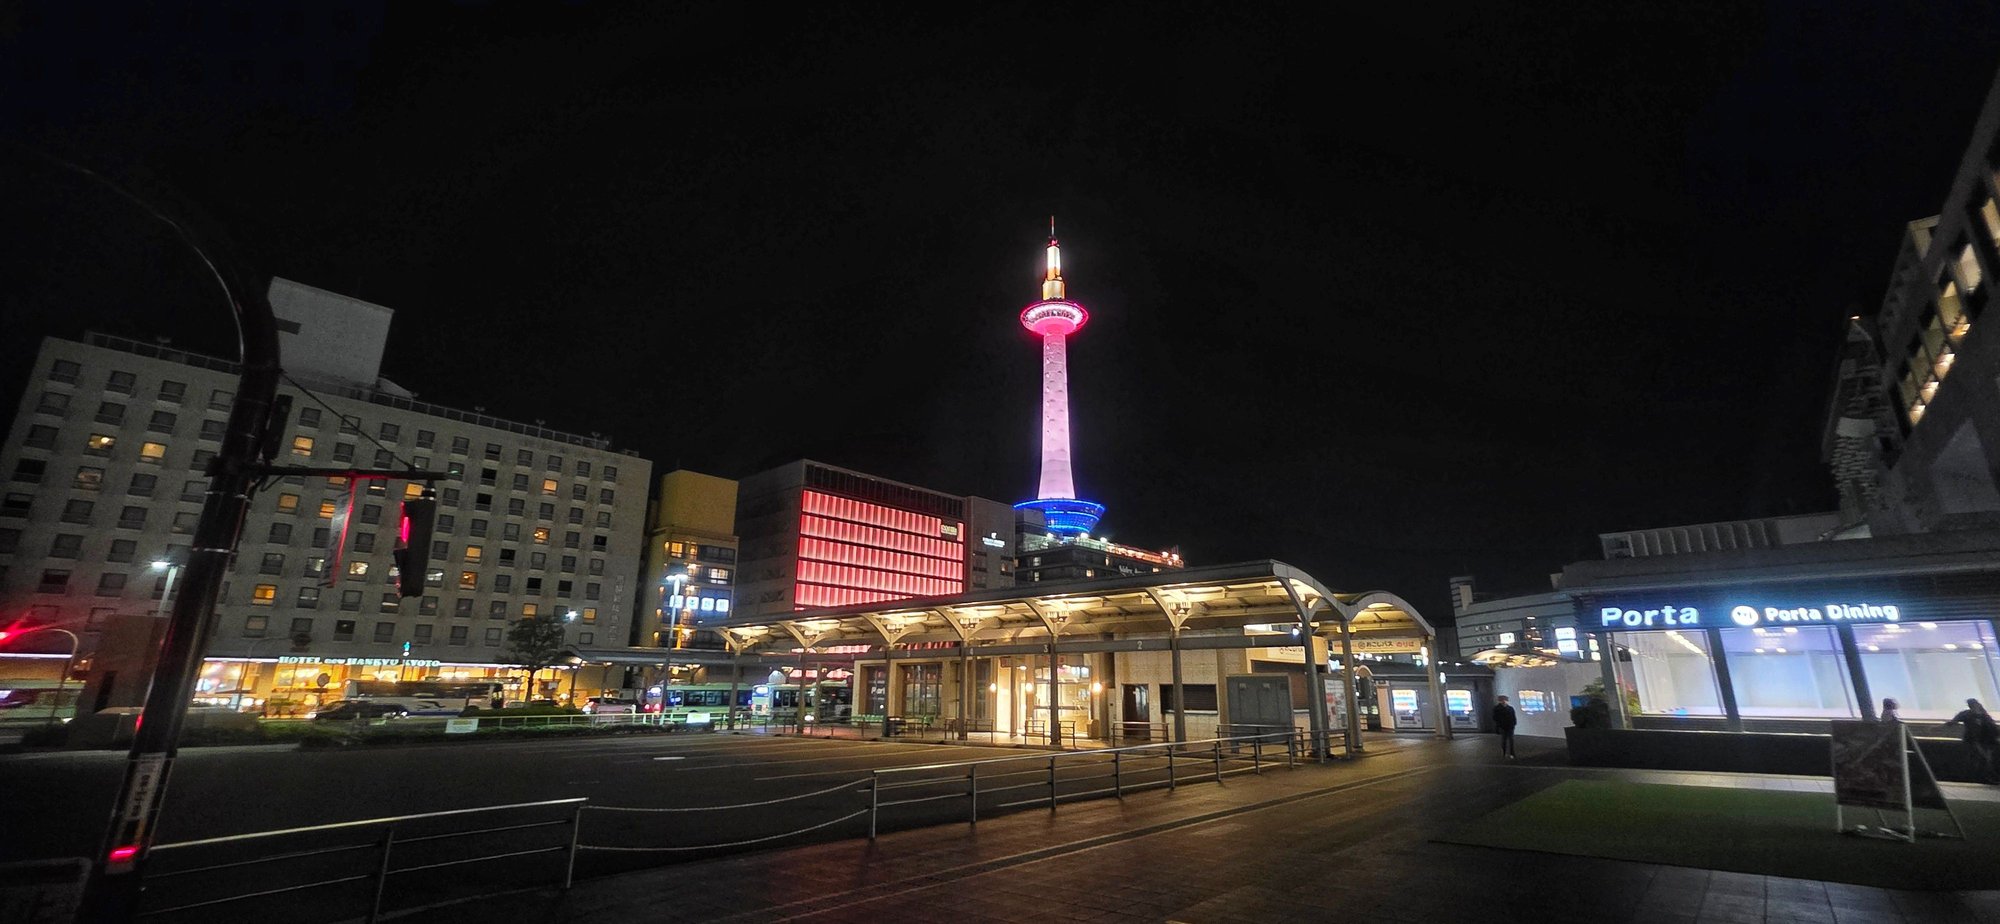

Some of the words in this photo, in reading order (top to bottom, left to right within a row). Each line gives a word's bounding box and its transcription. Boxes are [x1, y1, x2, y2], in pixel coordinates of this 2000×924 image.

[1601, 605, 1700, 626] Porta
[1764, 607, 1823, 621] Porta
[1825, 604, 1899, 620] Dining
[1043, 644, 1049, 653] 3
[1137, 641, 1143, 650] 2
[278, 656, 322, 665] HOTEL
[345, 657, 400, 666] HANKYU
[402, 659, 441, 667] KYOTO
